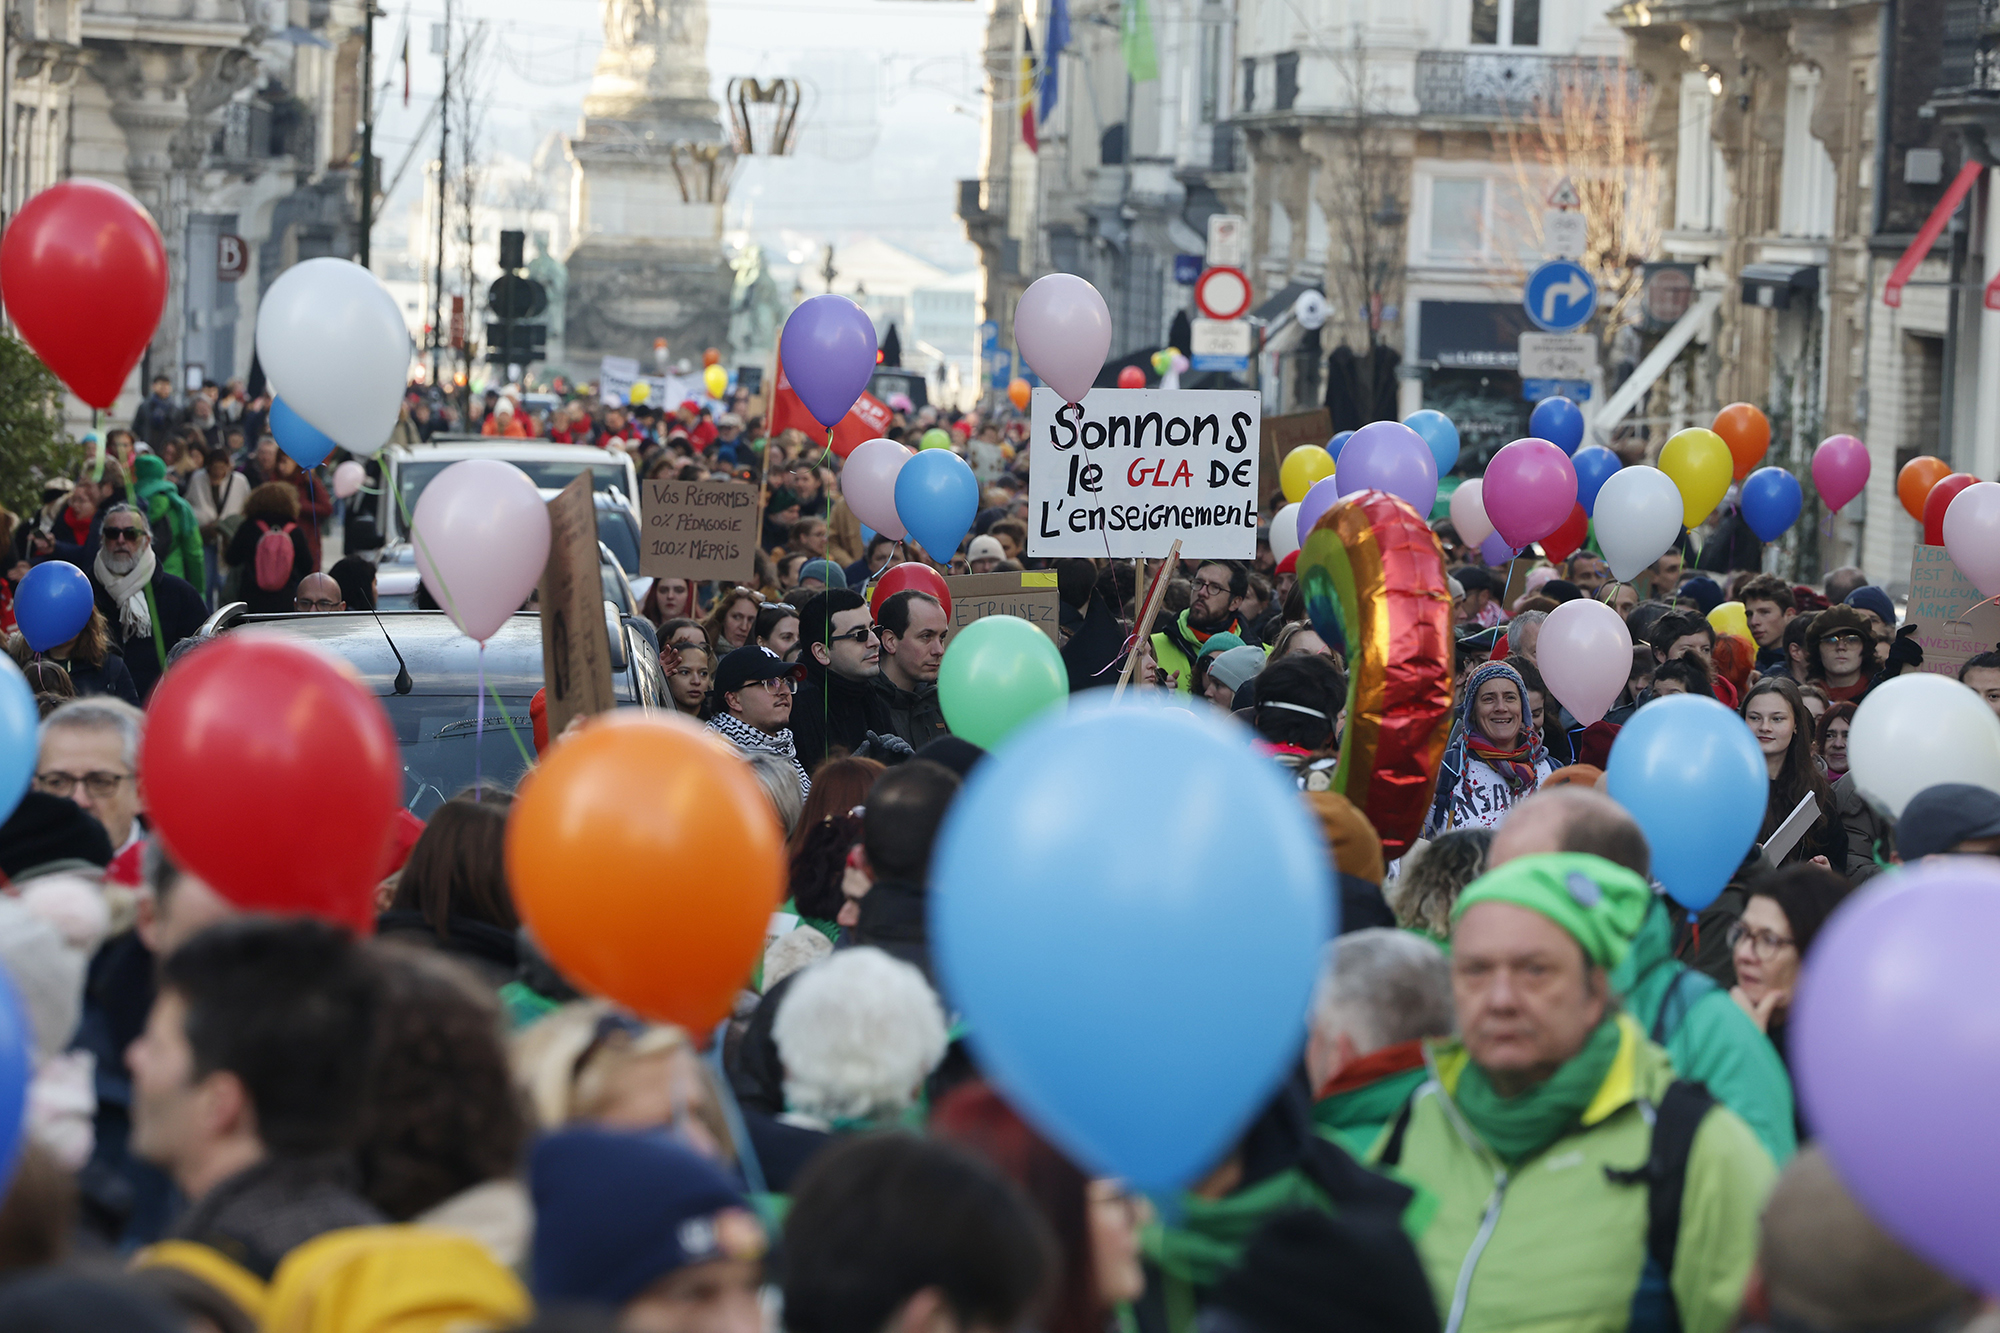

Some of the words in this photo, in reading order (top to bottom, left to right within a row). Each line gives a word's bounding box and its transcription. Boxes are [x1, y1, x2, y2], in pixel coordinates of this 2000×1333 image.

[220, 236, 241, 270] B
[1067, 455, 1103, 496] le
[1127, 457, 1194, 487] GLA
[1207, 459, 1251, 488] DE
[651, 513, 674, 528] 0%
[675, 513, 742, 532] PÉDAGOGIE
[1040, 498, 1257, 538] L'enseignement
[651, 540, 687, 556] 100%
[689, 539, 740, 560] MÉPRIS
[1914, 547, 1952, 562] L'EDU
[1914, 568, 1945, 581] EST
[955, 597, 1055, 627] ÉTRUISEZ
[1910, 635, 1989, 654] NVESTISSEZ
[1914, 661, 1964, 675] LUTÔT
